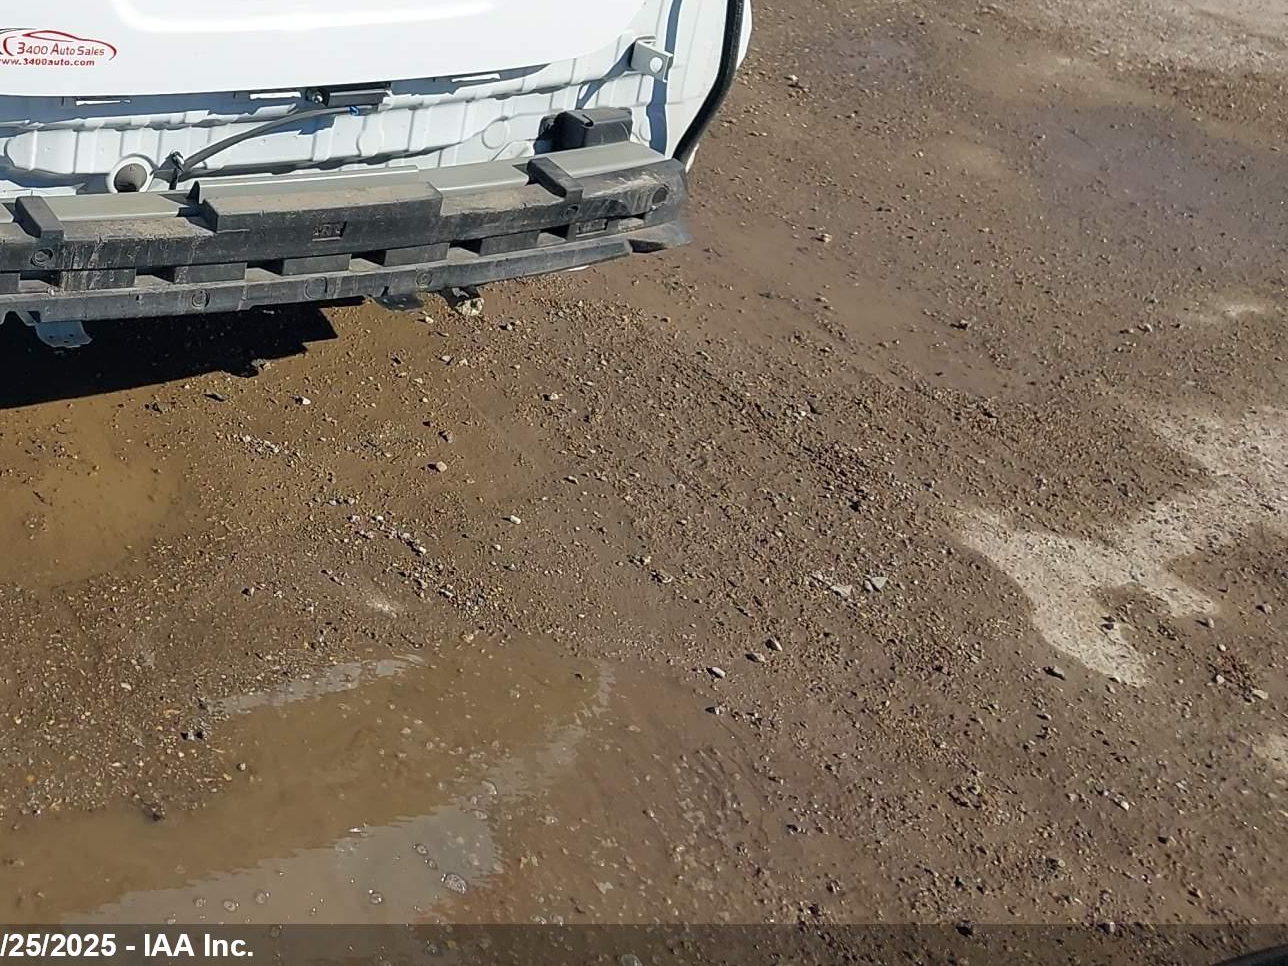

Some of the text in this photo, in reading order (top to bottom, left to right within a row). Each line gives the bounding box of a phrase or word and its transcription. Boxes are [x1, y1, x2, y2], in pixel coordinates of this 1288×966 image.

[16, 42, 105, 57] 3400 Auto Sales
